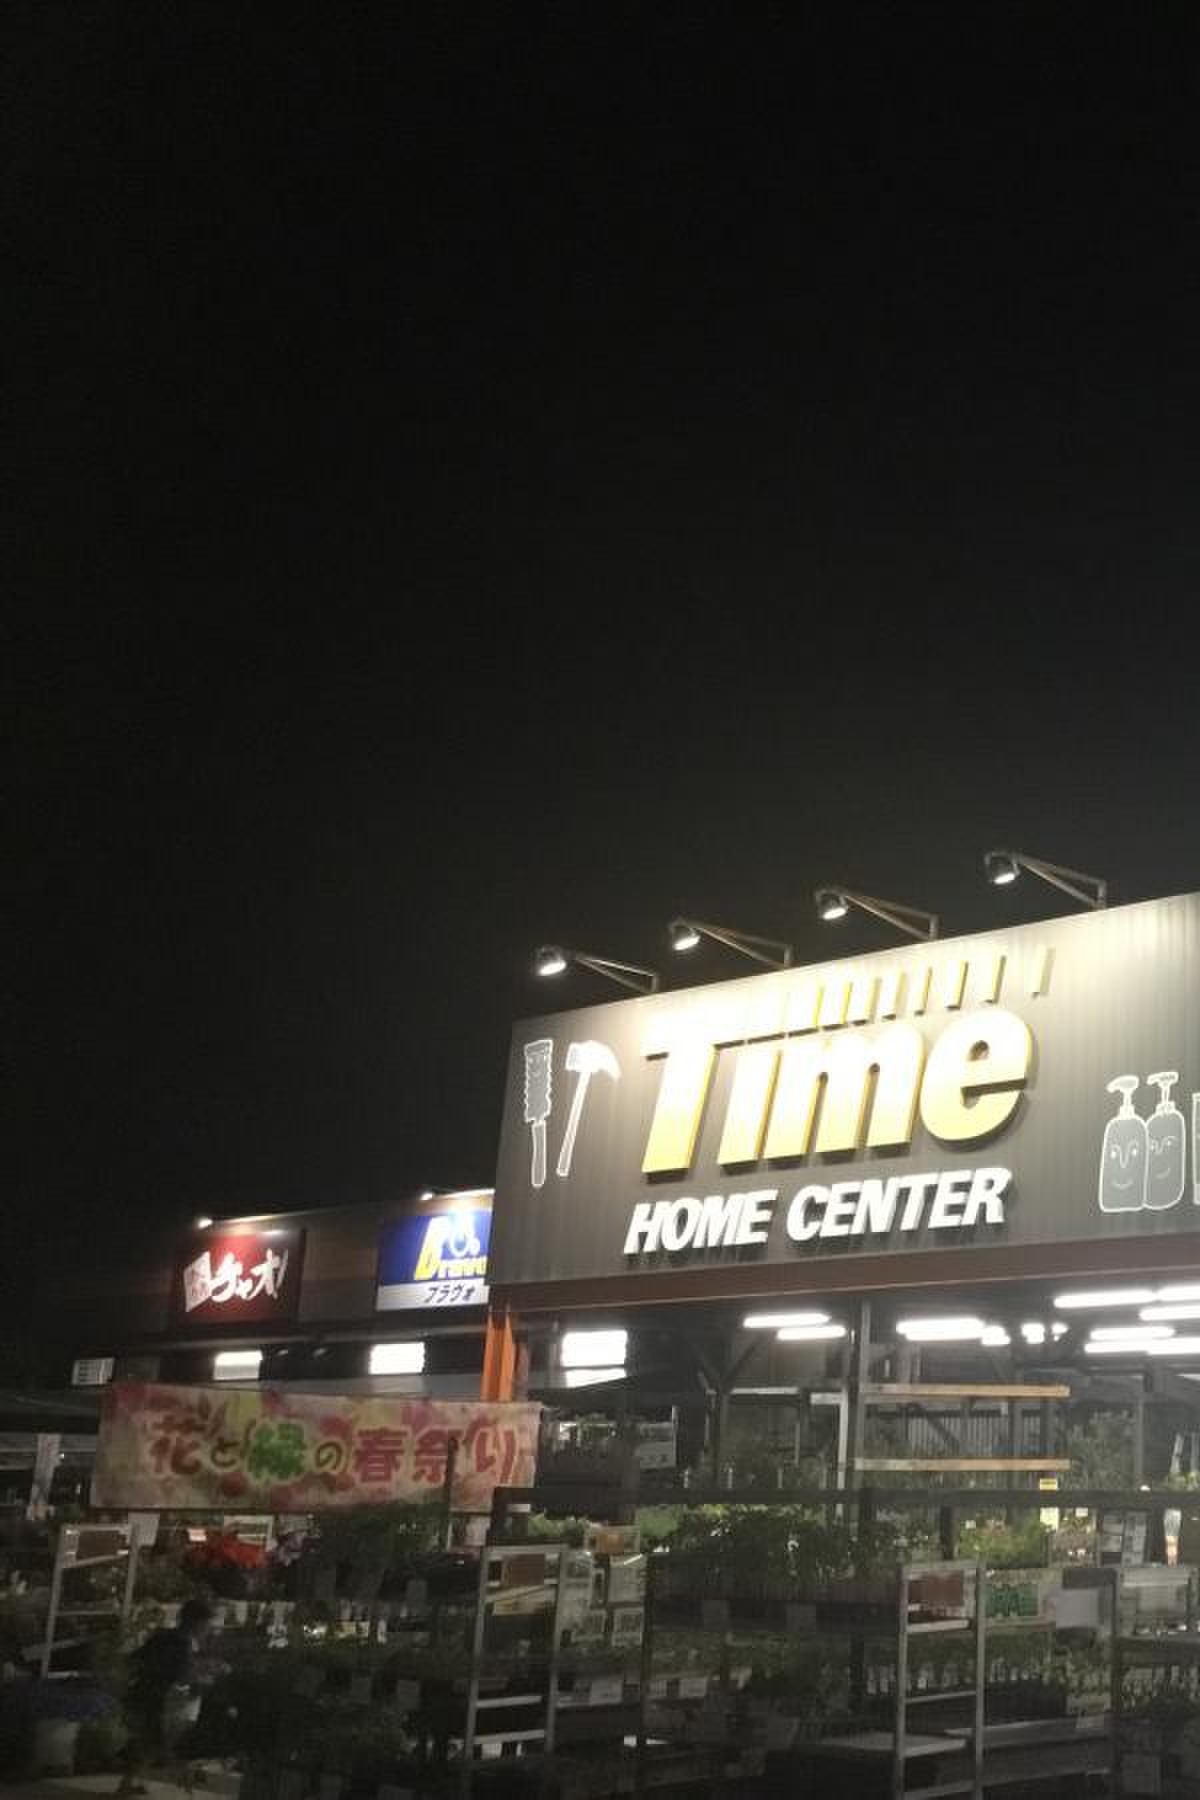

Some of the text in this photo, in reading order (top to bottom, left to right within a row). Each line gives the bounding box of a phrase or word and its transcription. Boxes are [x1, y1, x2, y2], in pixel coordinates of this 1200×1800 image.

[640, 975, 1036, 1174] Time
[623, 1167, 1012, 1254] HOME CENTER
